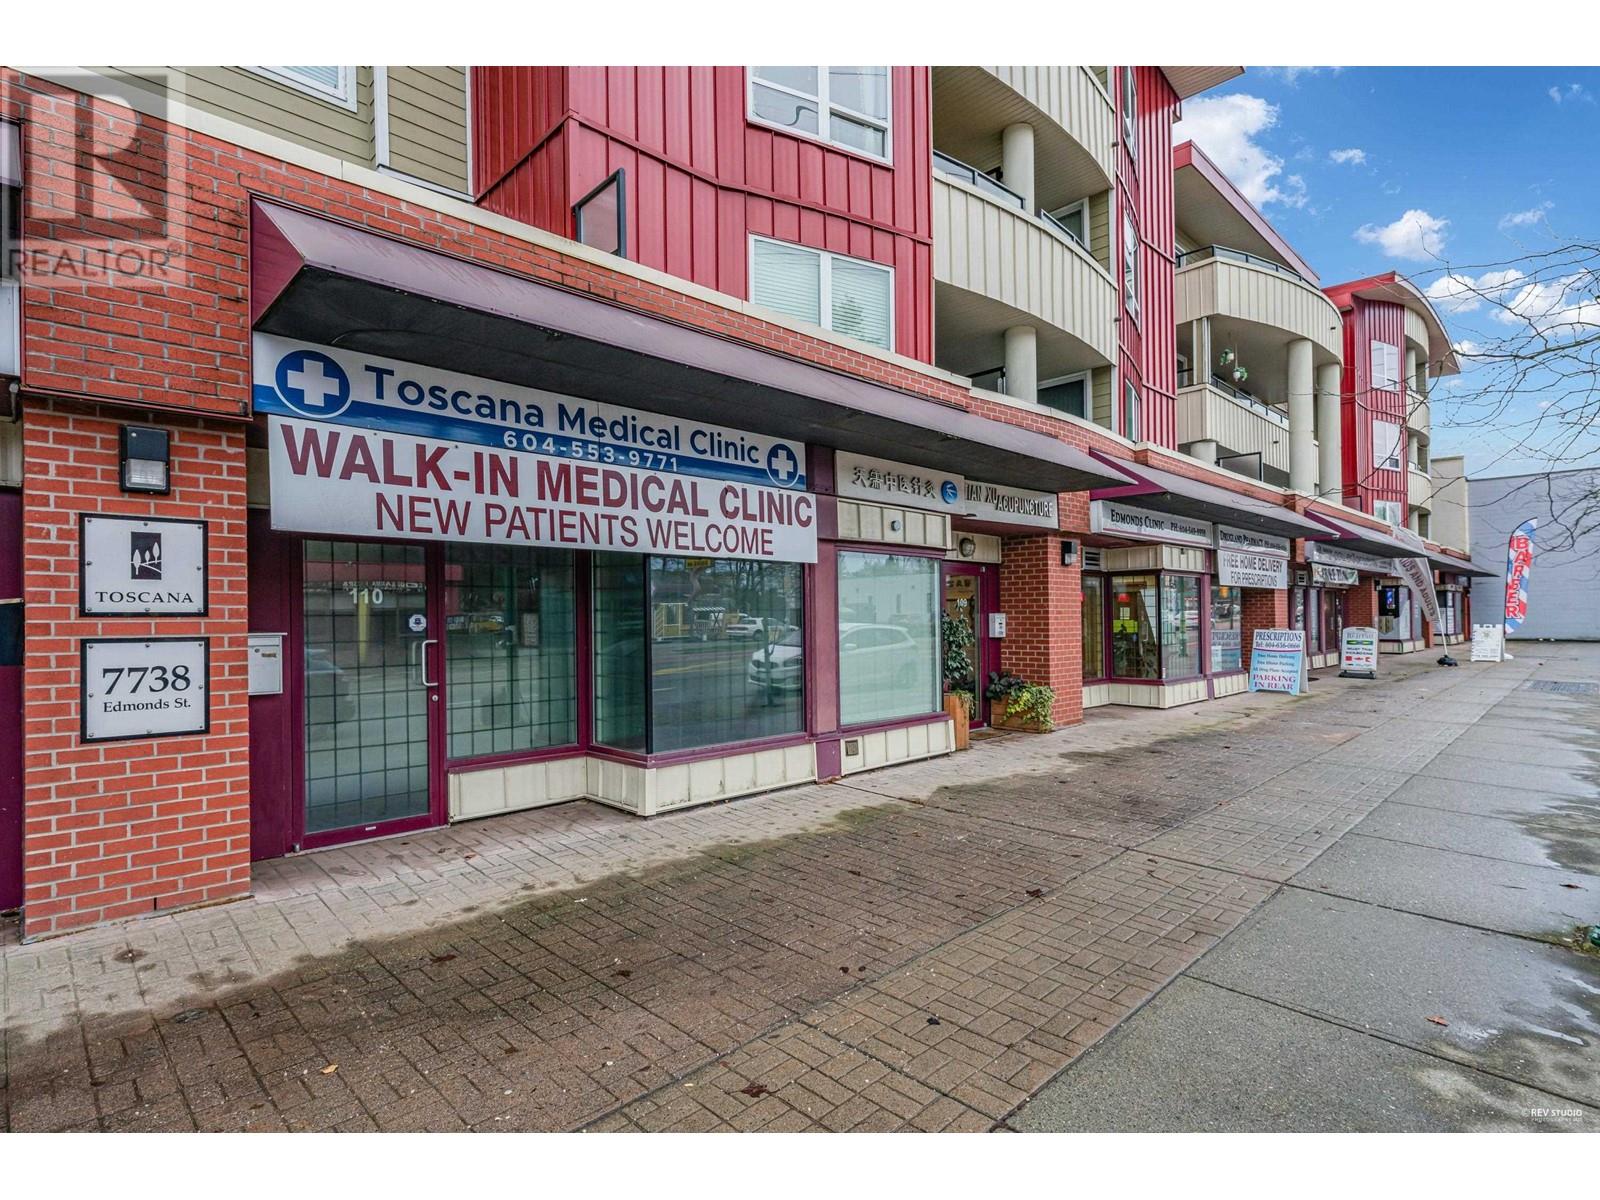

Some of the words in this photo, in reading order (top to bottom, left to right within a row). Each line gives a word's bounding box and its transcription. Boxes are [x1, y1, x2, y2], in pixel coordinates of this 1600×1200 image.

[364, 364, 544, 428] Toscana
[558, 403, 680, 451] Medical
[690, 429, 760, 464] Clinic
[503, 430, 678, 472] 604-553-9771
[280, 423, 519, 498] WALK-IN
[536, 460, 709, 518] MEDICAL
[719, 485, 812, 528] CLINIC
[995, 494, 1053, 518] ACUPUNCTURE
[376, 492, 471, 536] NEW
[485, 502, 639, 548] PATIENTS
[646, 518, 774, 556] WELCOME
[1223, 554, 1239, 569] FREE
[1240, 555, 1257, 571] HOME
[1258, 557, 1283, 574] DELIVERY
[1231, 571, 1241, 584] FOR
[1241, 572, 1278, 588] PRESCRIPTIONS
[1505, 535, 1530, 619] BARBER
[95, 591, 194, 604] TOSCANA
[349, 587, 384, 604] 110
[1254, 631, 1302, 642] PRESCRIPTIONS
[102, 664, 191, 695] 7738
[1253, 674, 1296, 683] PARKING
[1267, 682, 1294, 690] REAR
[103, 698, 170, 713] Edmonds
[174, 697, 191, 708] St.
